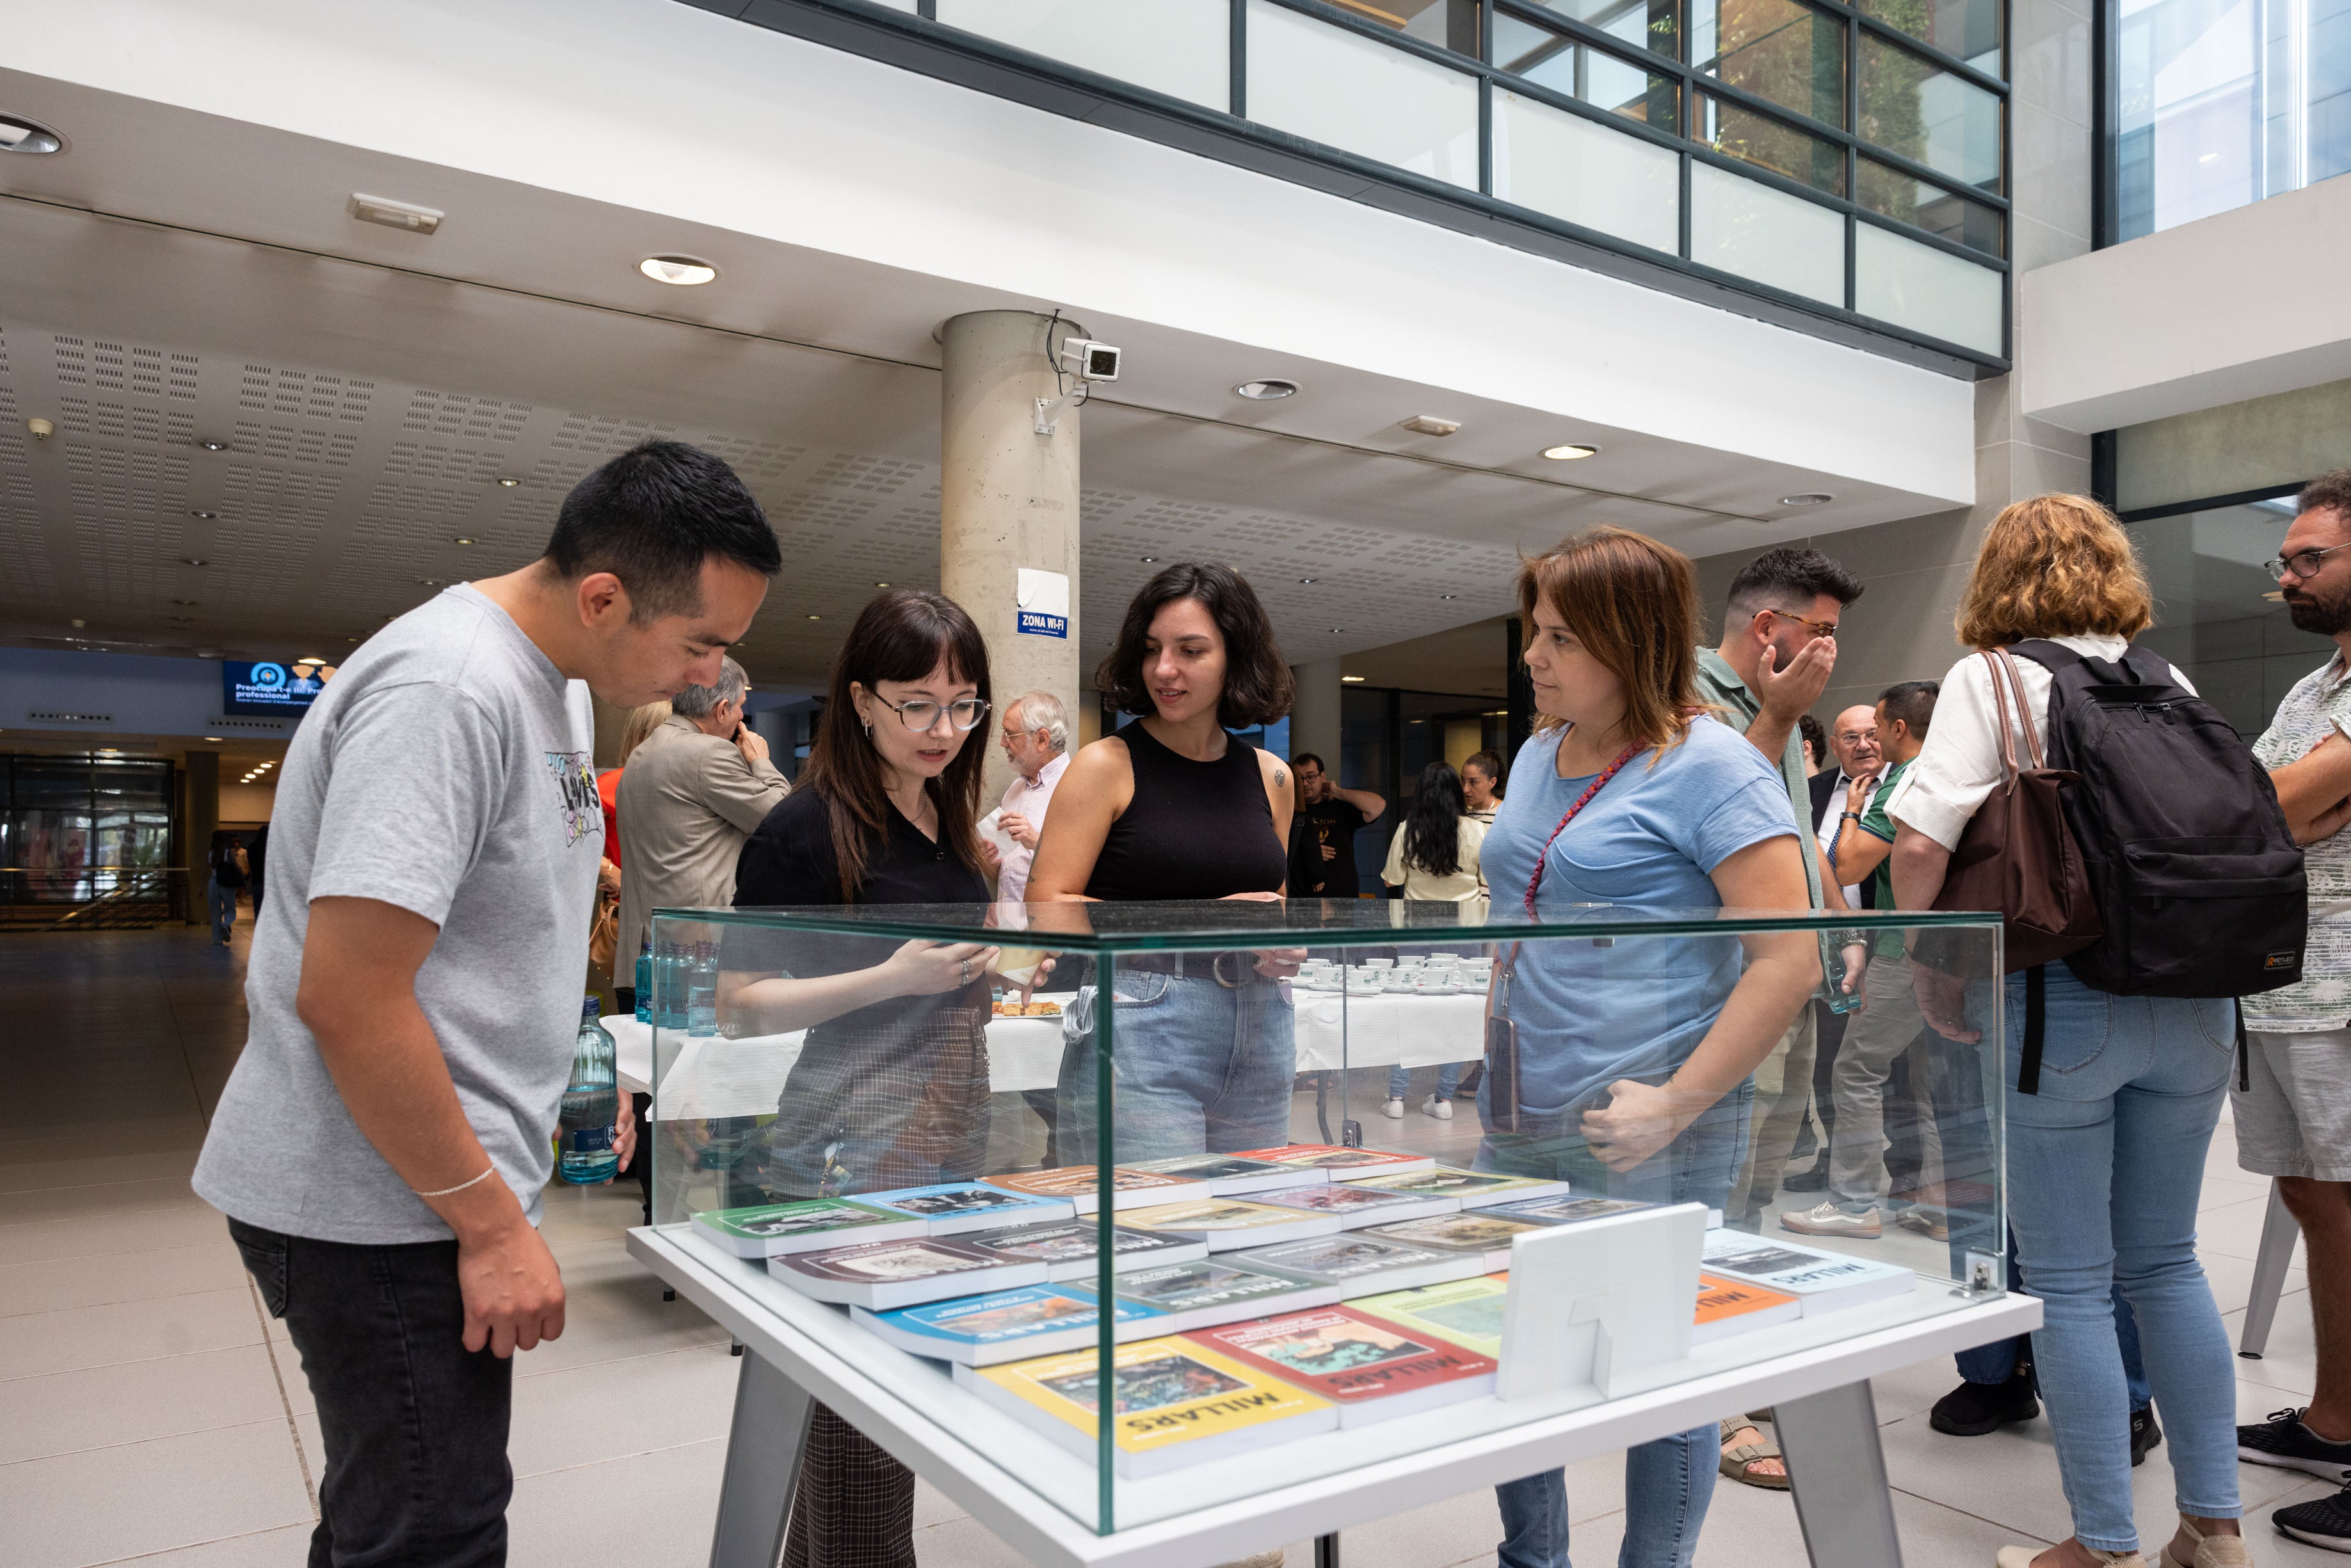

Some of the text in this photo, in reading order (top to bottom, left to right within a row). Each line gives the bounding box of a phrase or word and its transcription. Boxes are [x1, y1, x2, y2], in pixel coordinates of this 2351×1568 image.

[1022, 614, 1064, 630] ZONA WI-FI
[236, 691, 290, 700] professional
[1771, 1263, 1865, 1284] MILLARS
[1328, 1356, 1461, 1387] MILLARS
[1127, 1392, 1280, 1432] MILLARS
